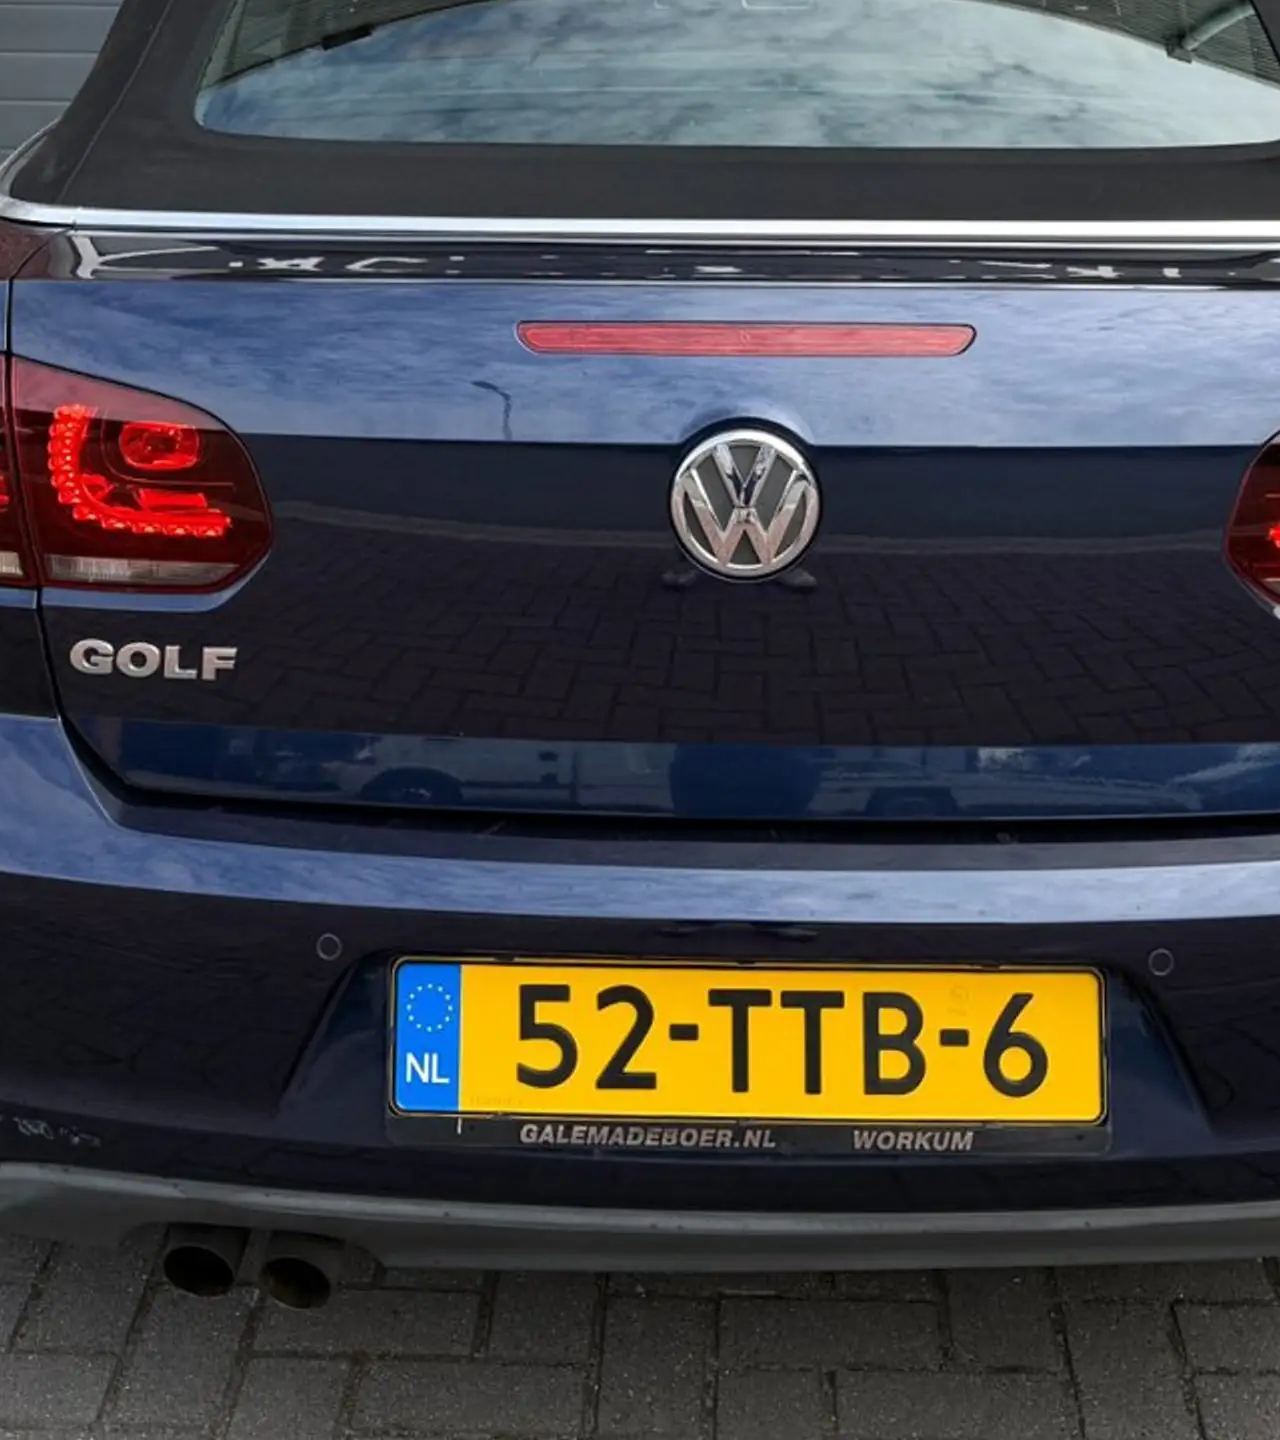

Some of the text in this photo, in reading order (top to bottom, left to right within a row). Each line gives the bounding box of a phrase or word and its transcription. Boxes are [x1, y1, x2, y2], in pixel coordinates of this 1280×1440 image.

[69, 638, 239, 681] GOLF
[406, 984, 1048, 1098] NL 52-TTB-6
[519, 1123, 976, 1152] GALEMADEBOER.NL WORKUM
